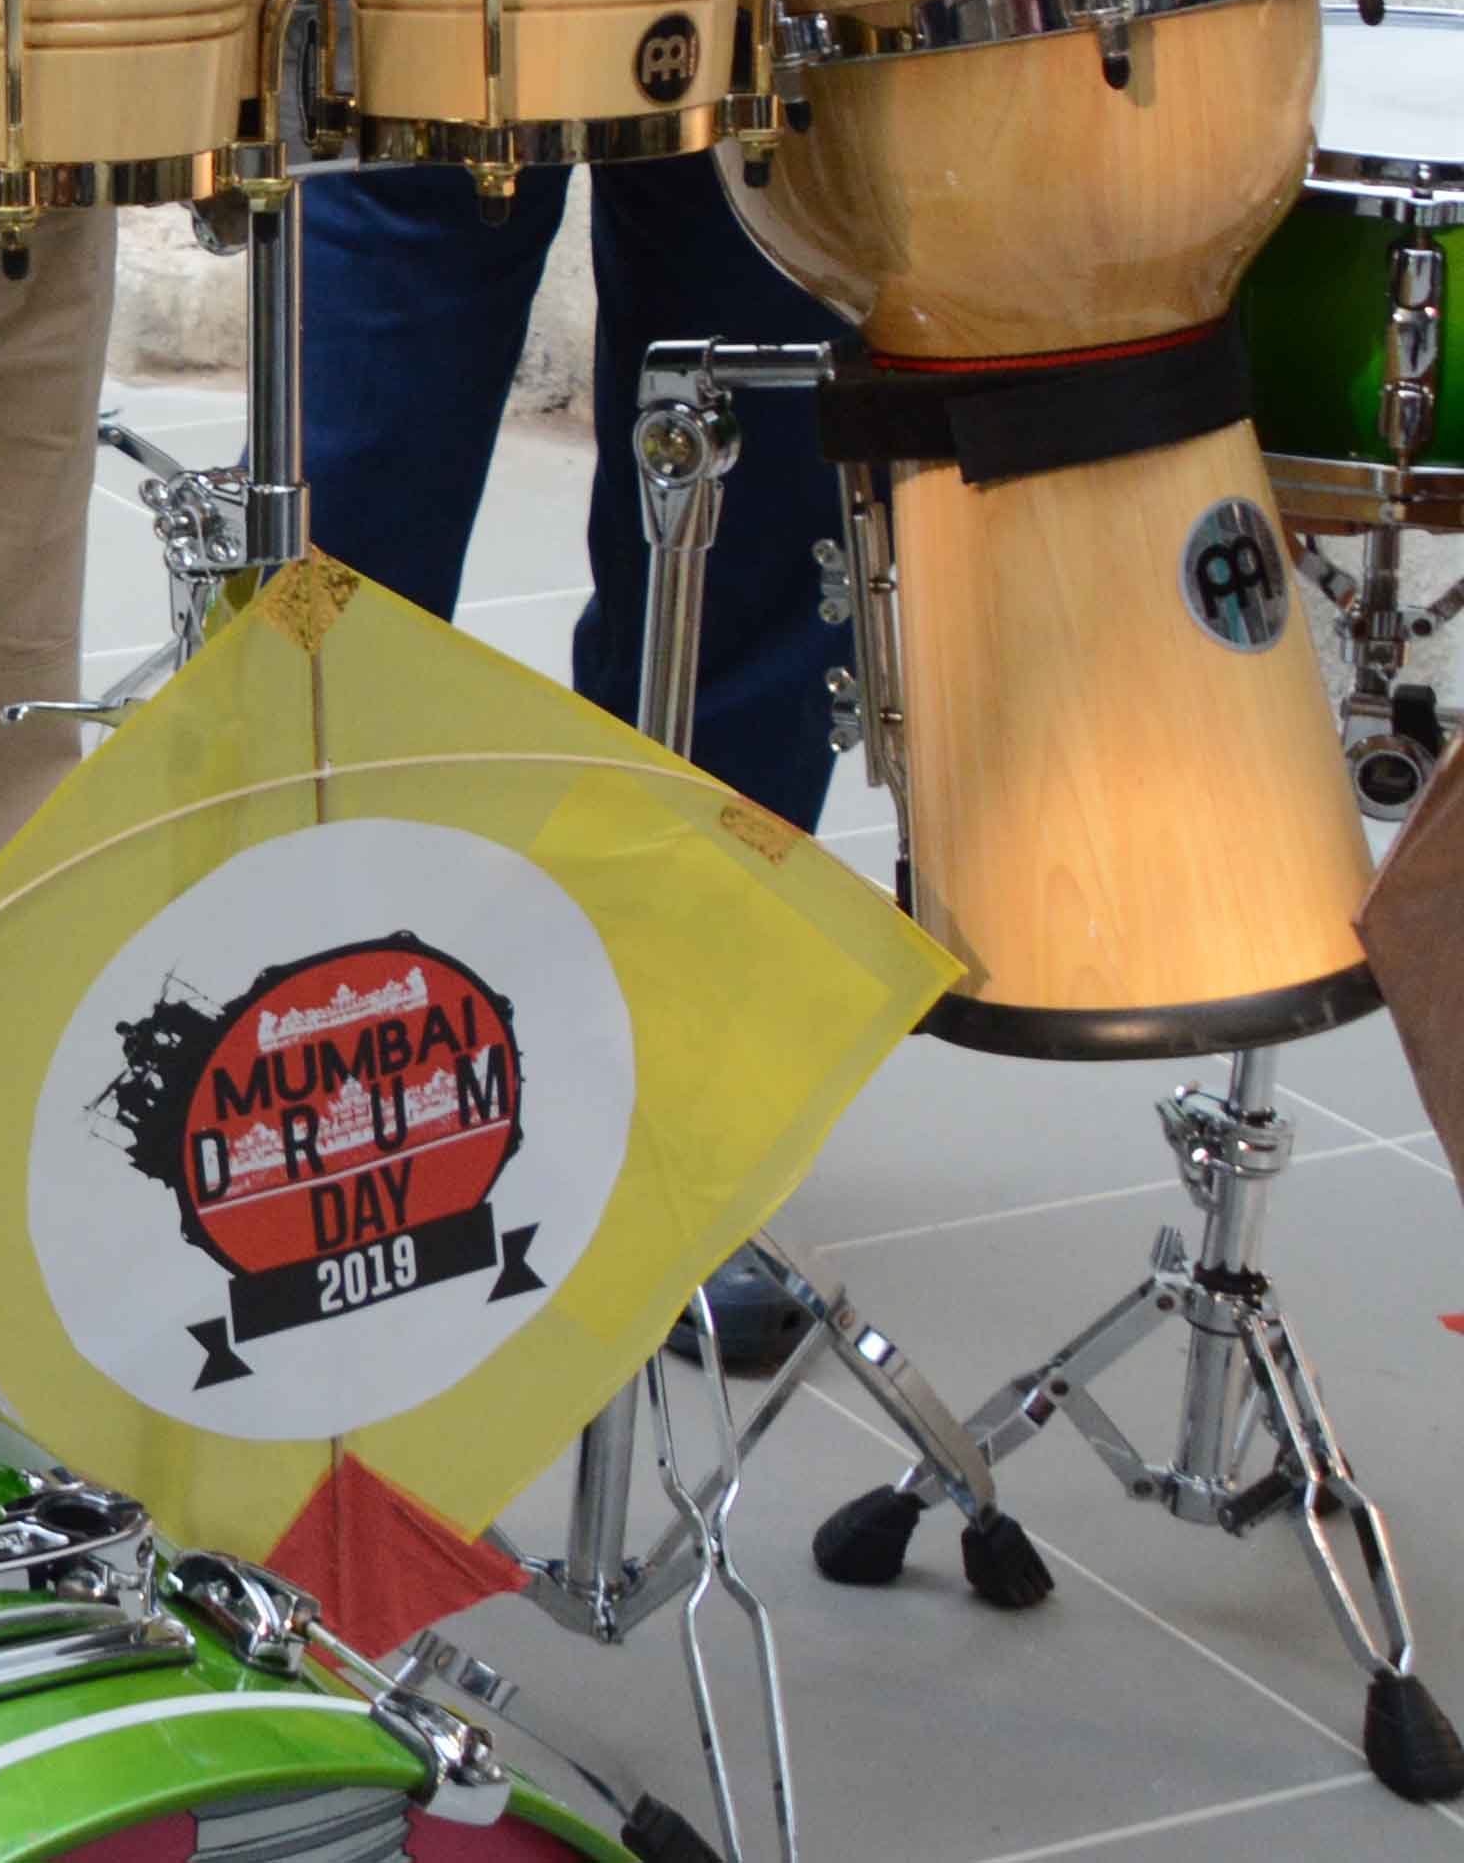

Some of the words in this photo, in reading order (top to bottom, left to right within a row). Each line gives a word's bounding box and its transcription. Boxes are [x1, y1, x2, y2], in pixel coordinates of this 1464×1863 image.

[212, 996, 479, 1123] MUMBAI
[189, 1043, 509, 1207] DRUM
[309, 1159, 414, 1256] DAY
[316, 1236, 418, 1315] 2019
